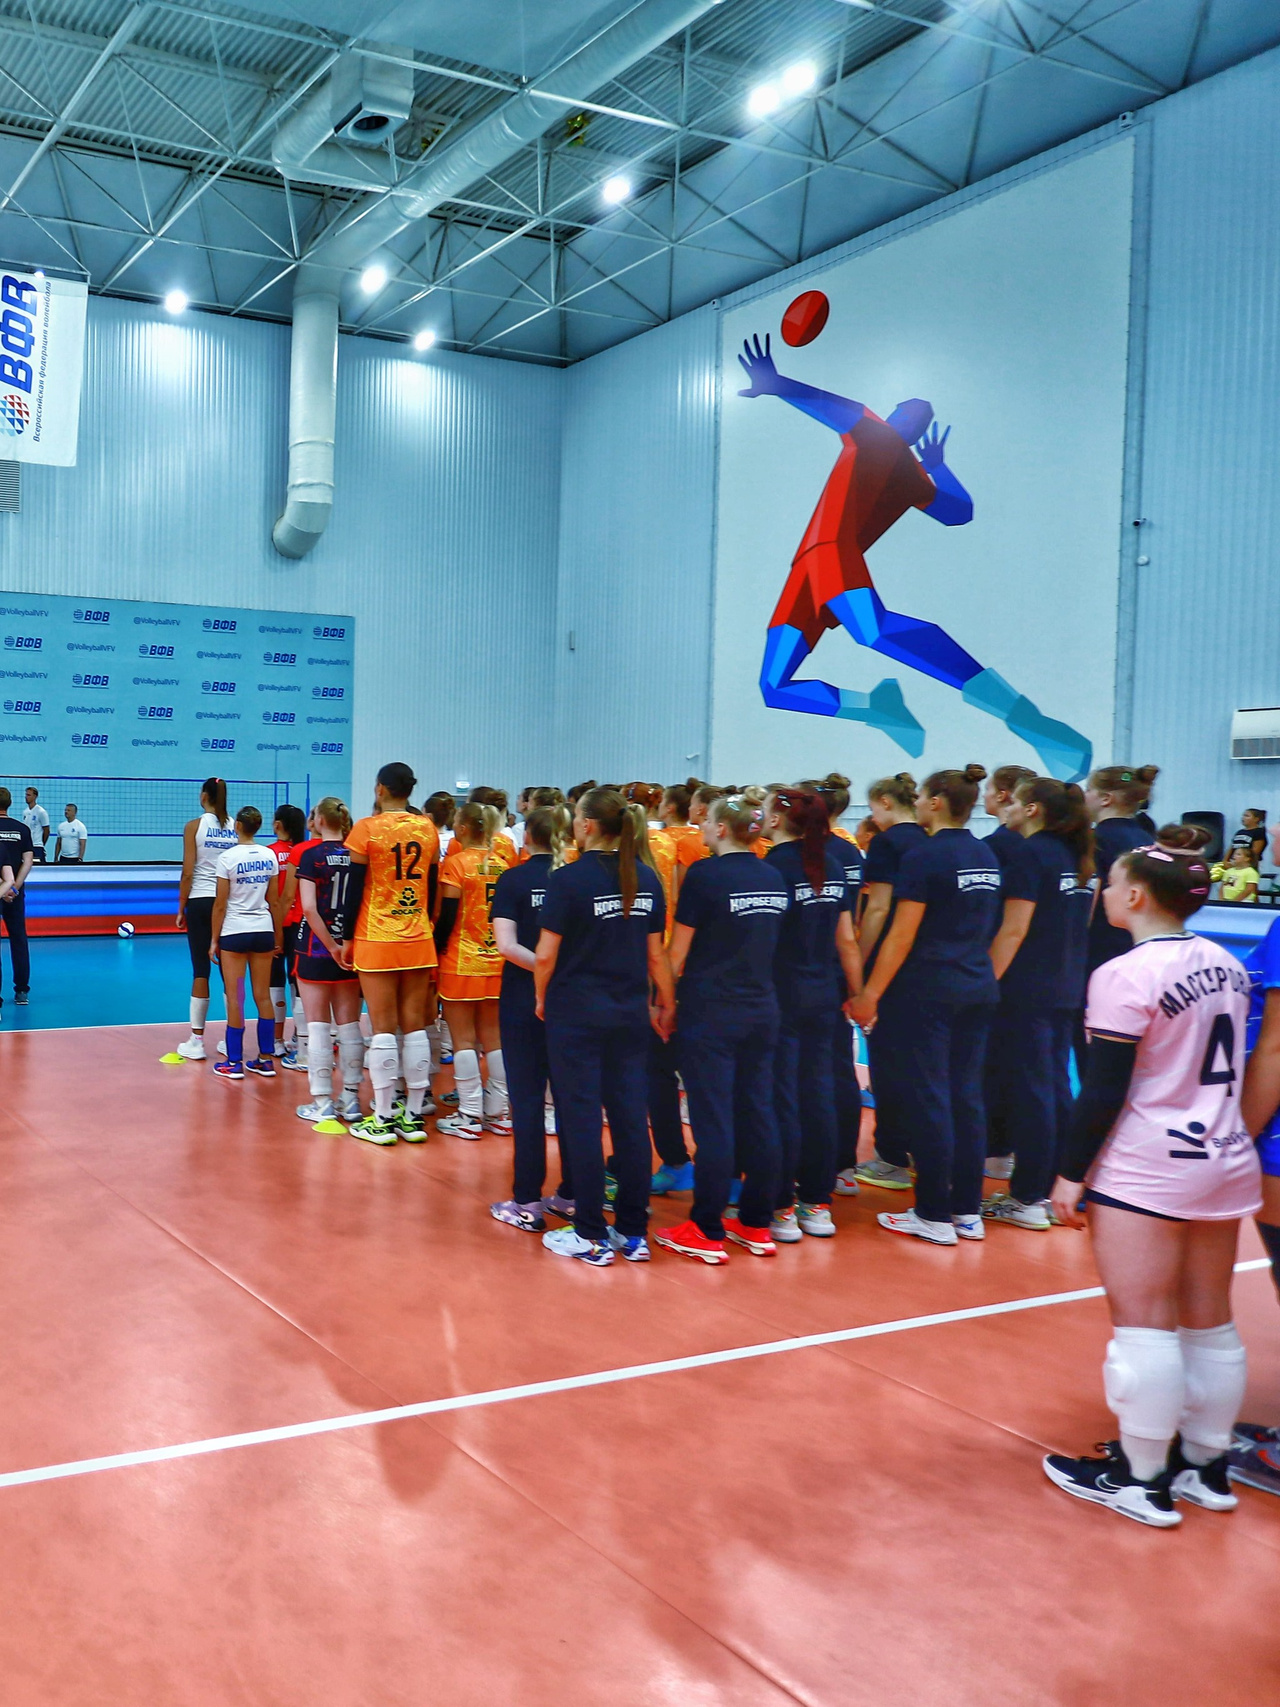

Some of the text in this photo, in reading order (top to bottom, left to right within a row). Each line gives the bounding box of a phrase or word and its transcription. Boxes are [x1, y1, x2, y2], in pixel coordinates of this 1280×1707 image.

[38, 329, 49, 378] федерация
[32, 379, 45, 443] Всероссийская
[83, 609, 111, 623] ВФВ
[211, 619, 238, 631] ВФВ
[321, 626, 346, 639] ВФВ
[14, 636, 43, 649] ВФВ
[148, 644, 175, 657] ВФВ
[272, 652, 297, 664] ВФВ
[82, 674, 110, 687] ВФВ
[211, 681, 237, 693] ВФВ
[321, 686, 345, 698] ВФВ
[13, 700, 42, 713] ВФВ
[147, 706, 174, 718] ВФВ
[271, 711, 296, 723] ВФВ
[81, 733, 109, 746] ВФВ
[210, 738, 236, 750] ВФВ
[320, 742, 344, 753] ВФВ
[391, 841, 422, 881] 12
[1200, 1013, 1237, 1097] 4
